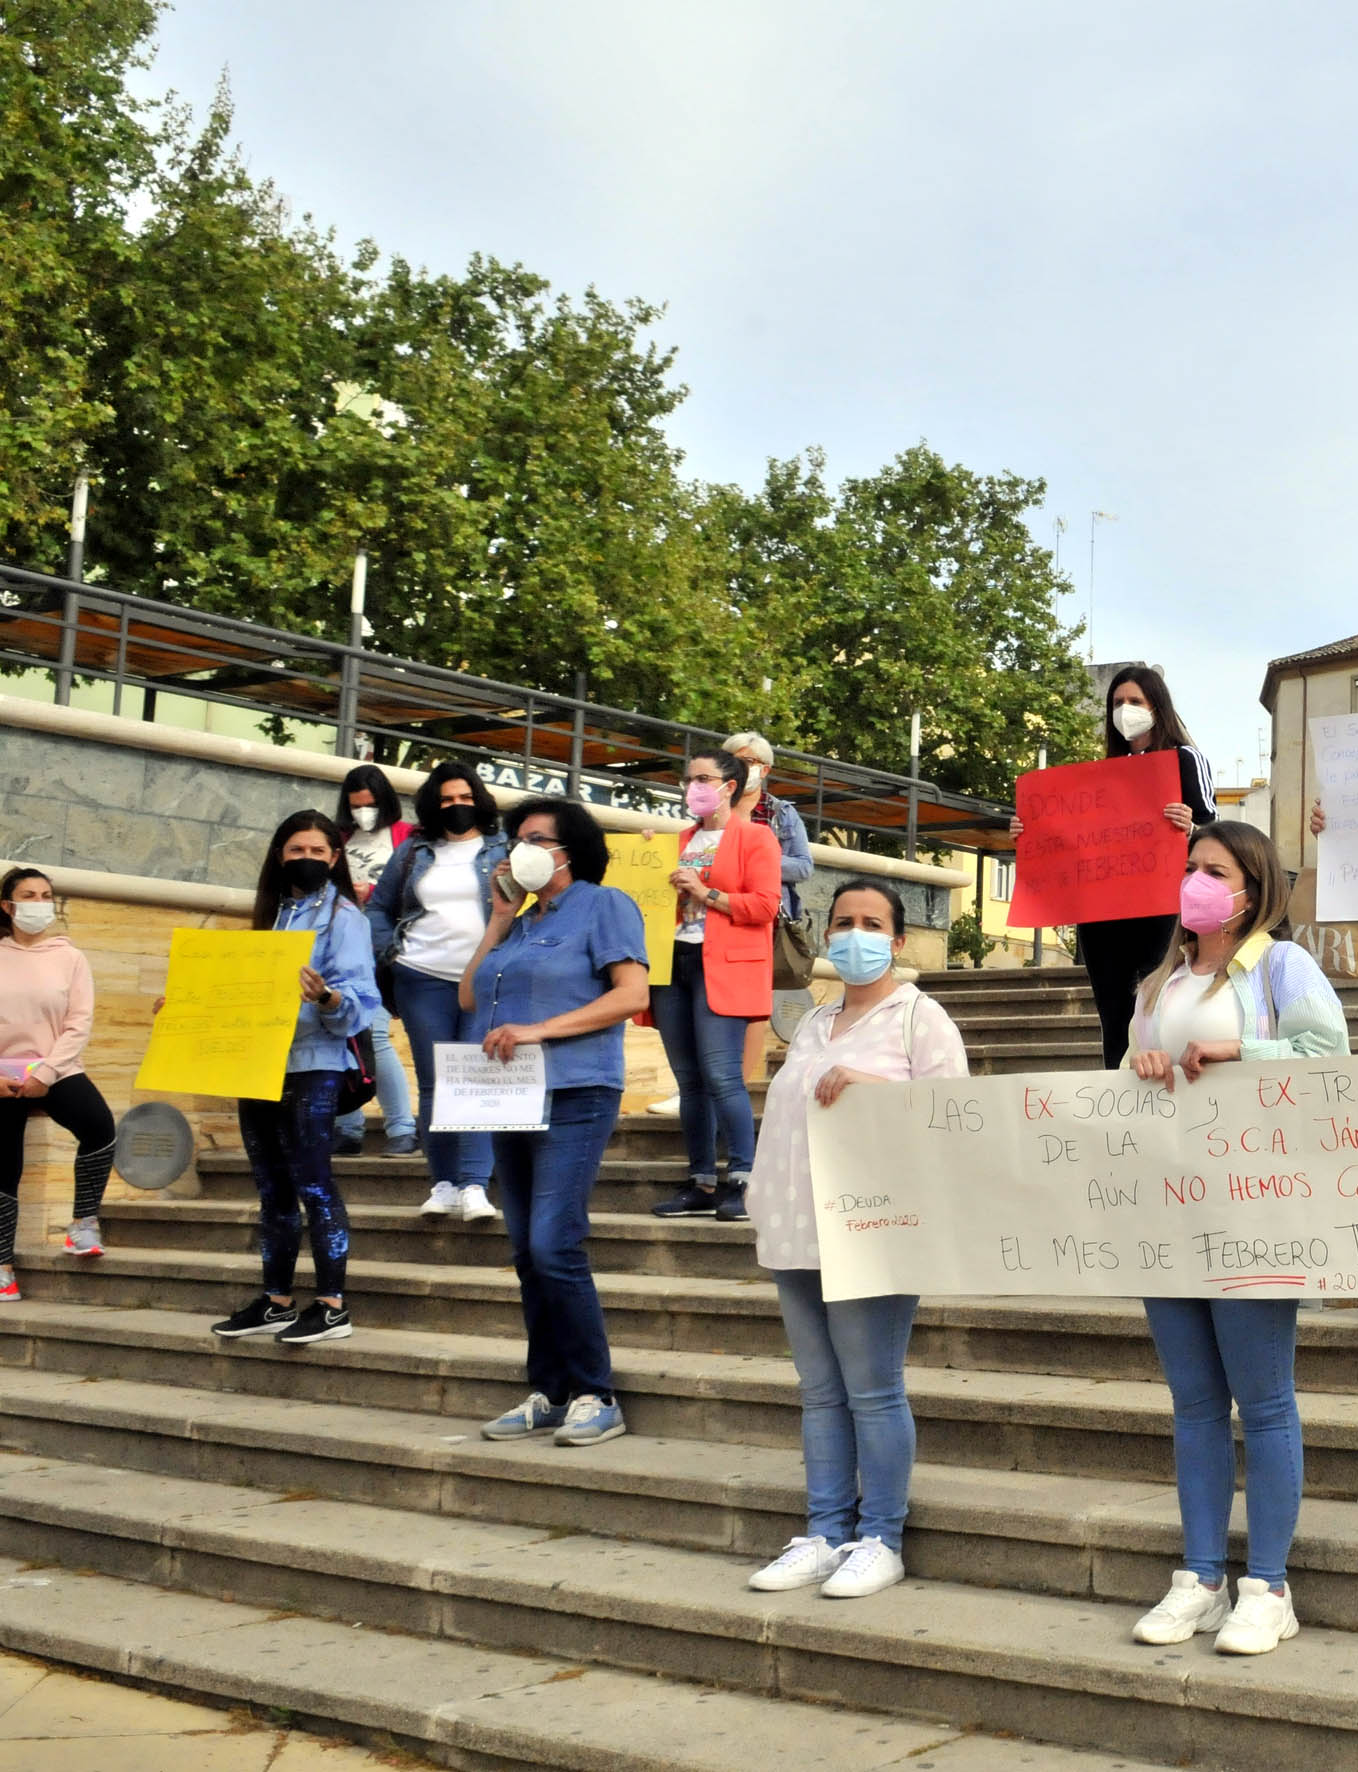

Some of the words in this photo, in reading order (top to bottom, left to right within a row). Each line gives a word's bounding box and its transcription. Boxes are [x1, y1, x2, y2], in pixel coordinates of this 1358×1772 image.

[631, 849, 663, 869] LOS
[1024, 1086, 1176, 1120] EX-SOCIAS
[1185, 1096, 1219, 1134] y
[1037, 1134, 1081, 1165] DE
[1106, 1131, 1139, 1157] LA
[1087, 1171, 1138, 1209] AÚN
[1164, 1175, 1206, 1206] NO
[1228, 1171, 1313, 1201] HEMOS
[1000, 1234, 1032, 1272] EL
[1053, 1234, 1120, 1273] MES
[1139, 1242, 1174, 1271] DE
[1192, 1230, 1328, 1271] FEBRERO
